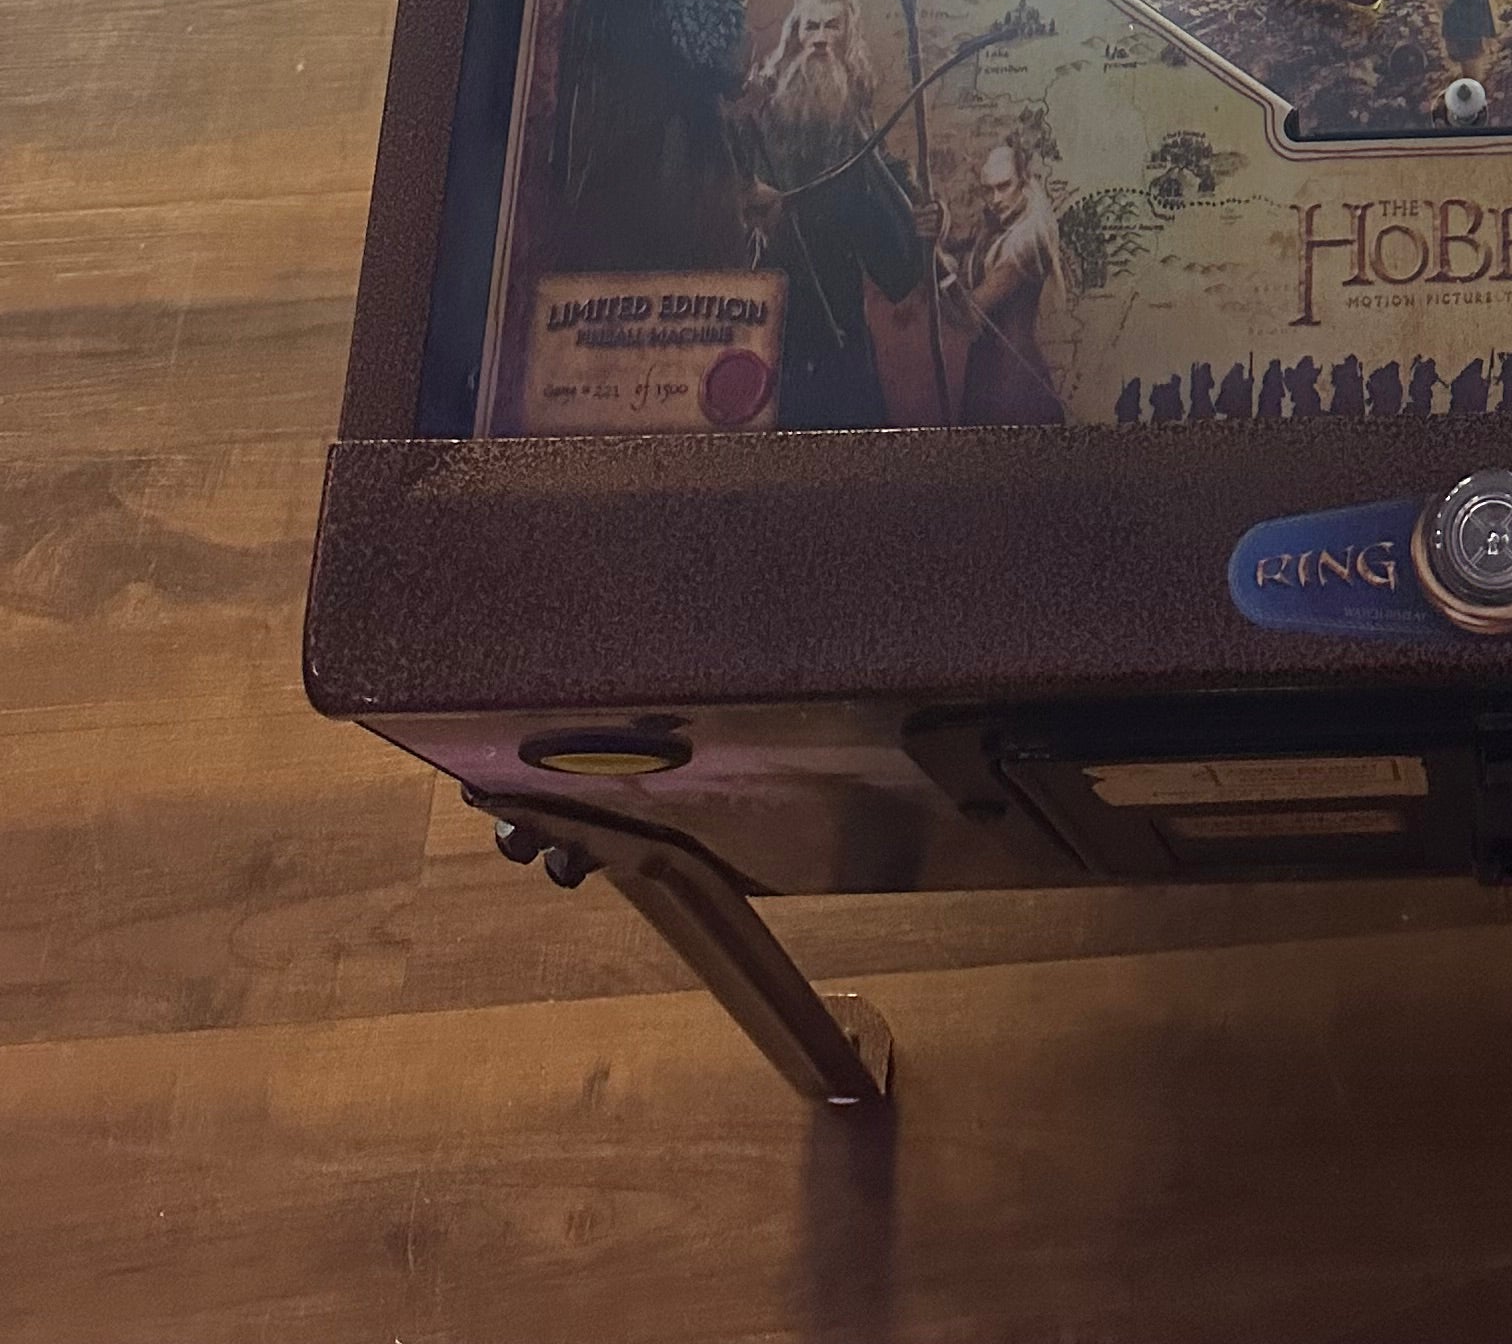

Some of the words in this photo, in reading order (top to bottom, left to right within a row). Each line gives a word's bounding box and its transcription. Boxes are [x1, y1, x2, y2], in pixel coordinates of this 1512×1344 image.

[1378, 199, 1420, 217] THE
[547, 295, 652, 333] LIMITED
[658, 293, 768, 325] EDITION
[1346, 292, 1416, 309] MOTION
[1426, 290, 1493, 306] PICTURE
[1254, 539, 1398, 591] RING
